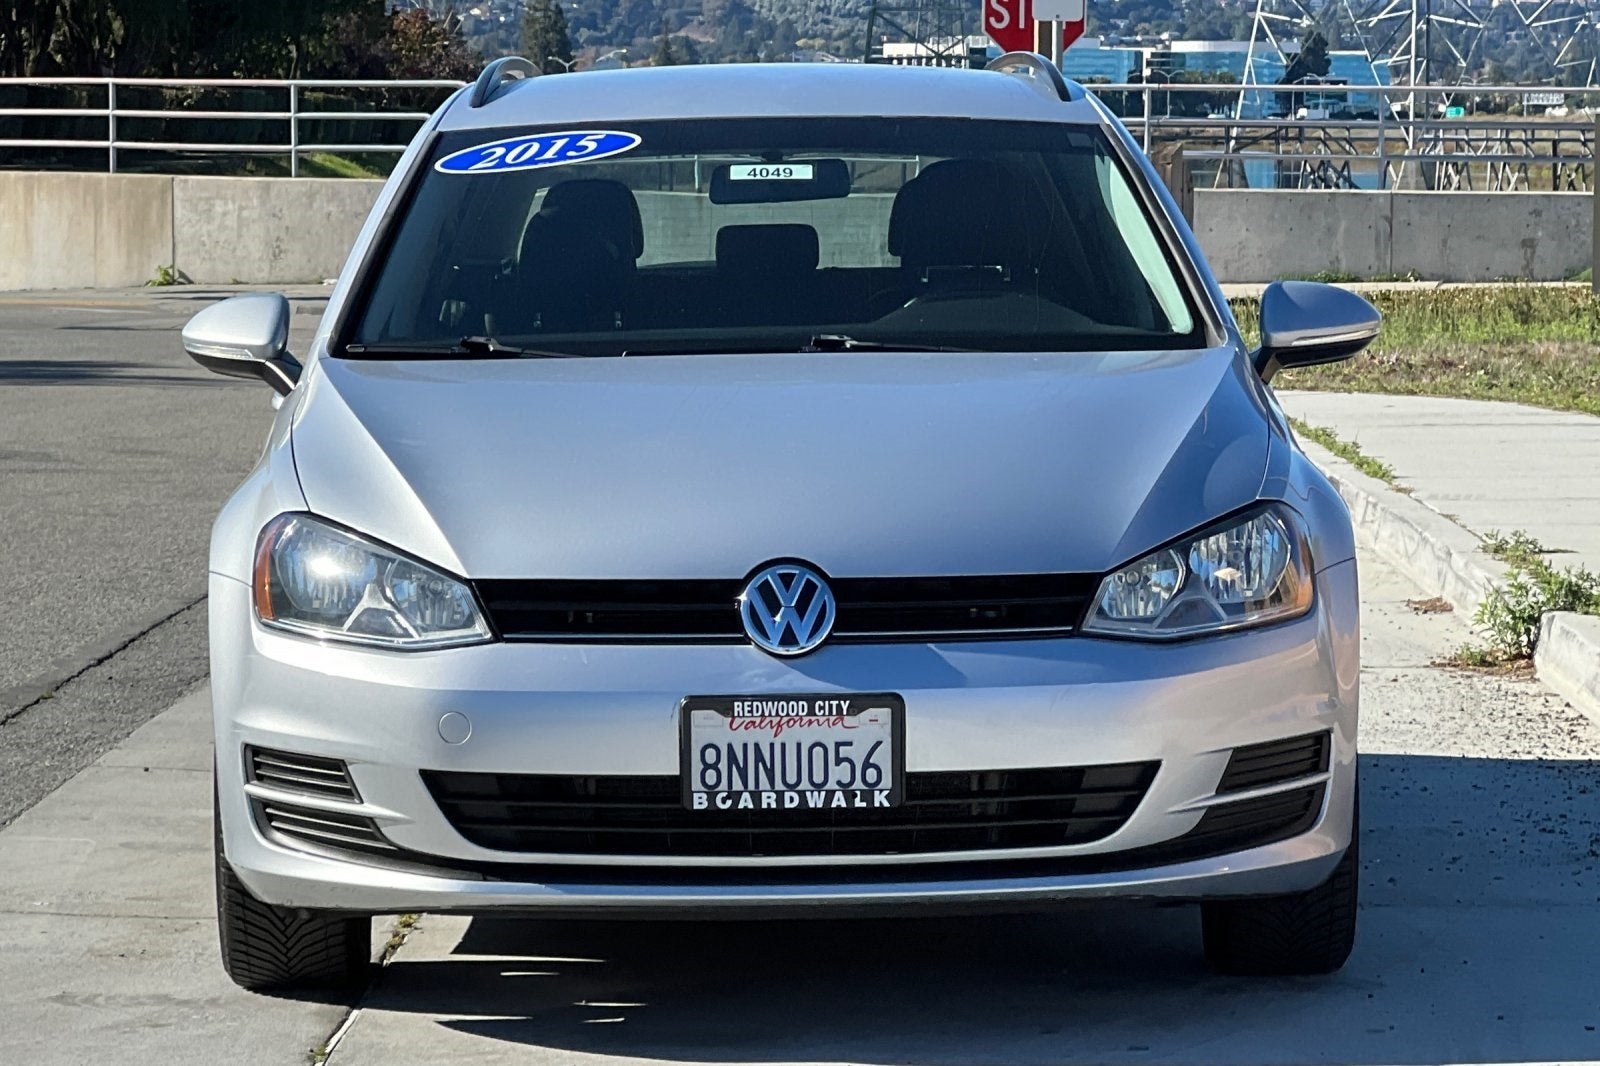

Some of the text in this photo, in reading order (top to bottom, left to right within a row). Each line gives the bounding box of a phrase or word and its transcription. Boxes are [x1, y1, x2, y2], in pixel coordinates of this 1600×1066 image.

[468, 133, 606, 170] 2015
[747, 167, 793, 178] 4049
[733, 700, 850, 717] REDWOOD CITY
[728, 715, 859, 738] California
[700, 740, 884, 790] 8NNU056
[692, 790, 891, 810] BOARDWALK
